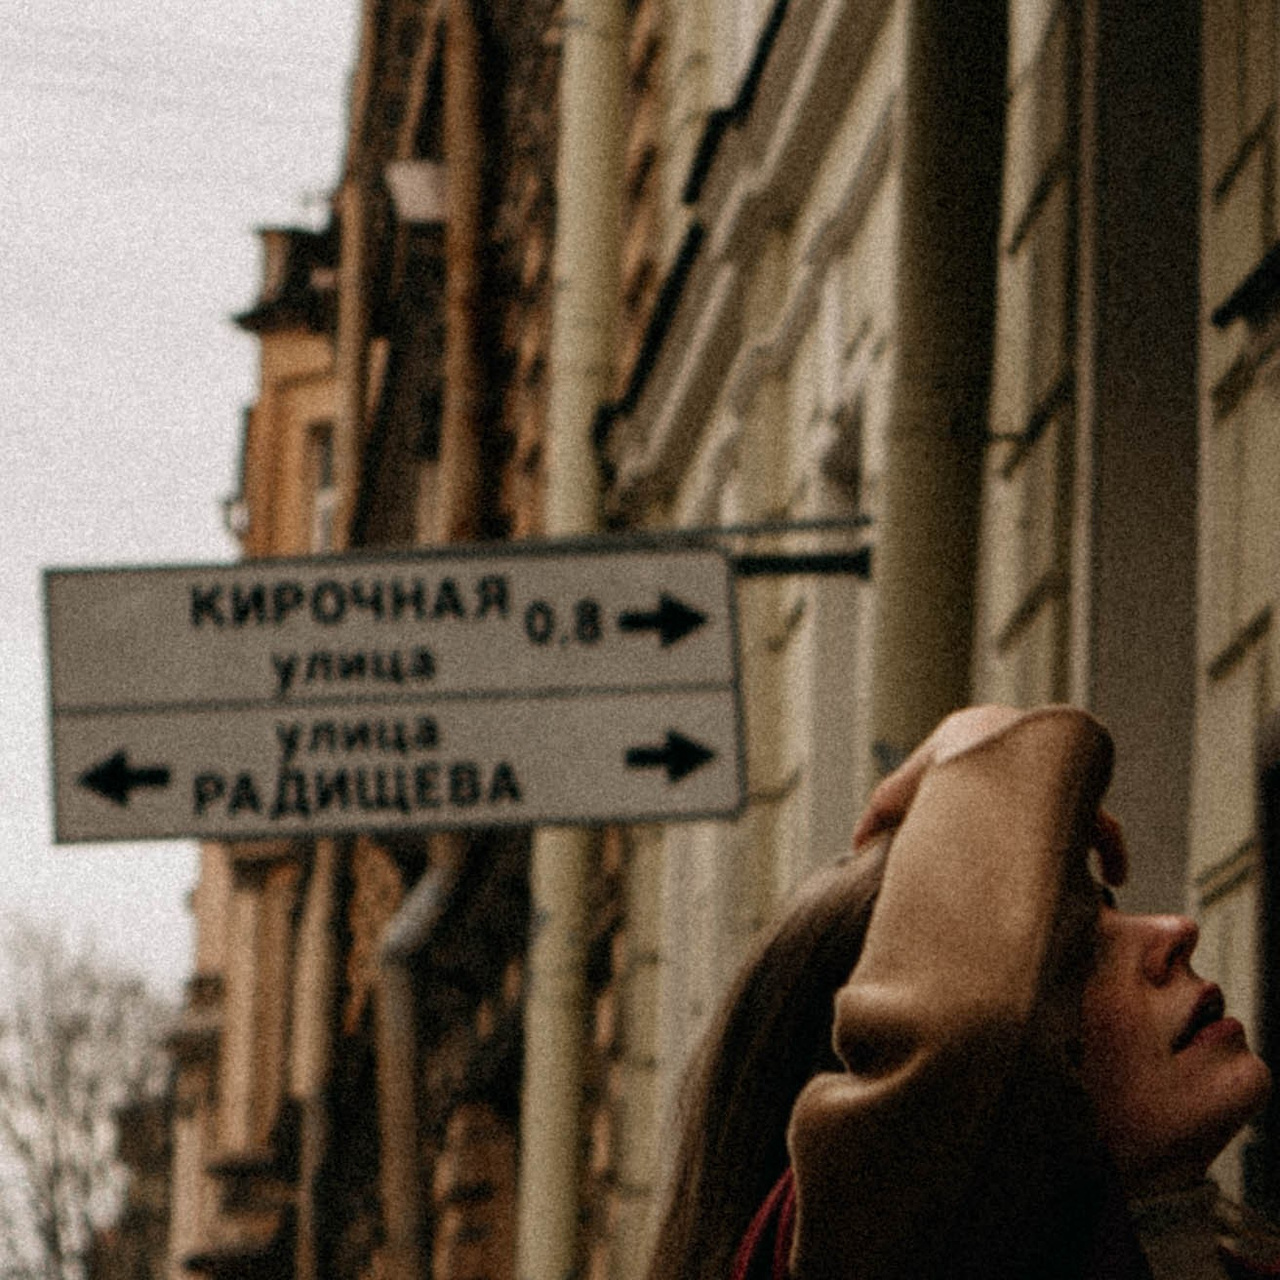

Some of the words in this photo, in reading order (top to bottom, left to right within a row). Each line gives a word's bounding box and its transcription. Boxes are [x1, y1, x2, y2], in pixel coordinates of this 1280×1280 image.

[190, 575, 512, 630] КИРОЧНАЯ
[271, 646, 437, 694] улица
[276, 716, 442, 762] улица
[194, 761, 522, 821] РАДИЩЕВА
